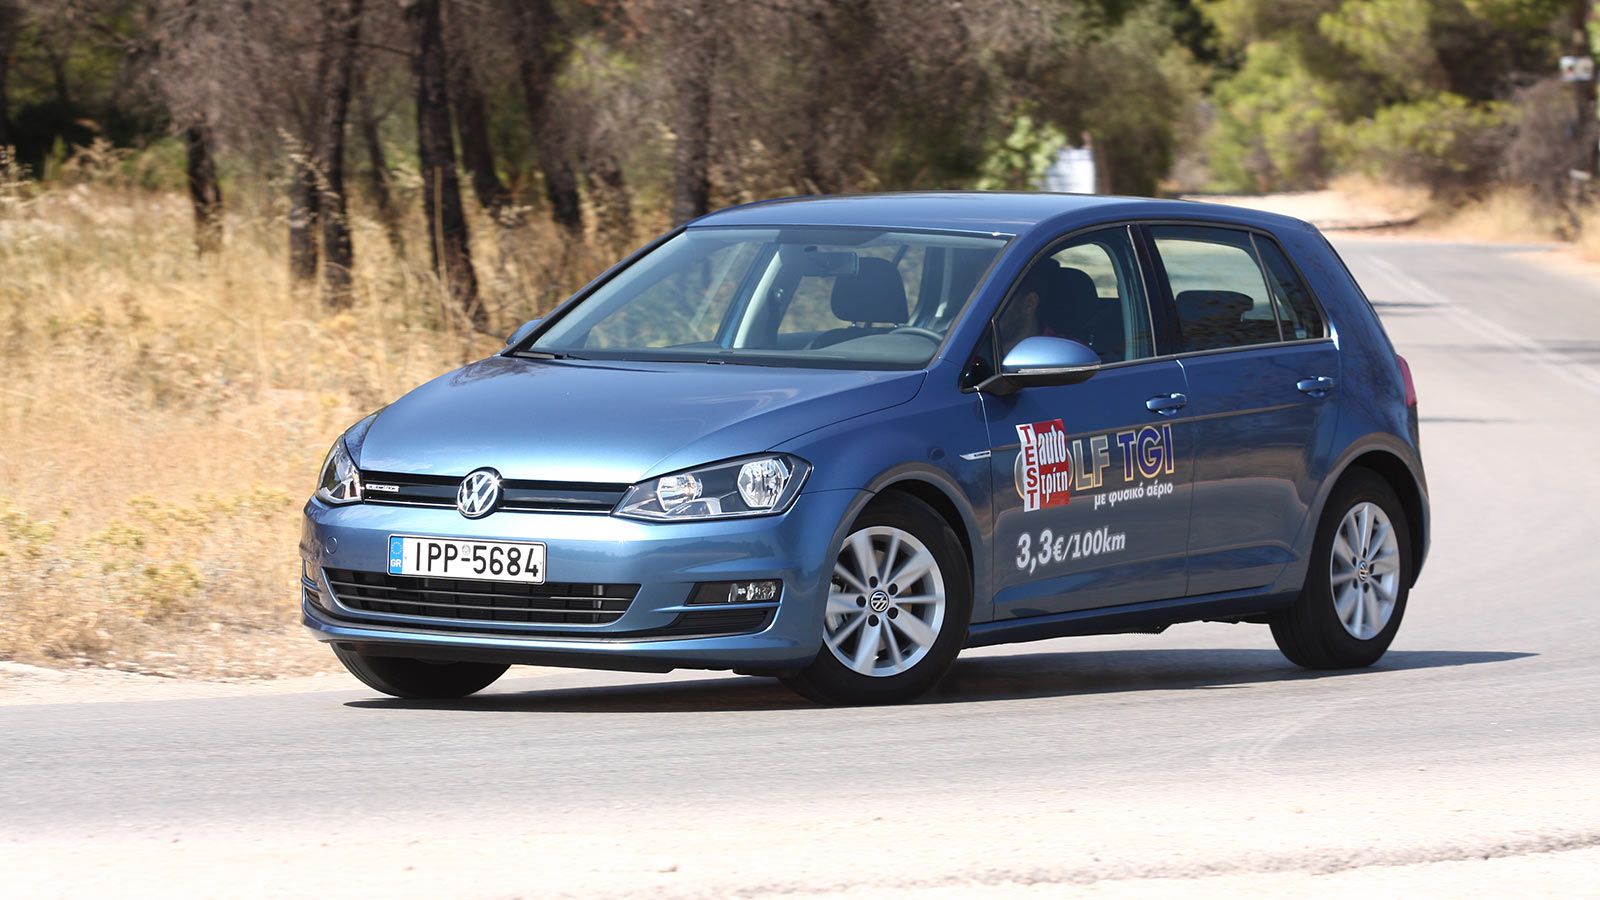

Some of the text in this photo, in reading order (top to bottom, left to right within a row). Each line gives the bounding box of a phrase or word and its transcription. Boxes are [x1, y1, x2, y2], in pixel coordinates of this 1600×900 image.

[1038, 424, 1066, 466] auto
[1117, 423, 1175, 481] TGI
[1020, 425, 1038, 508] TEST
[1040, 467, 1068, 503] τρίτη
[1094, 480, 1173, 509] με φυσικό αέριο
[390, 559, 402, 568] GR
[1016, 526, 1126, 574] 3,3€/100km
